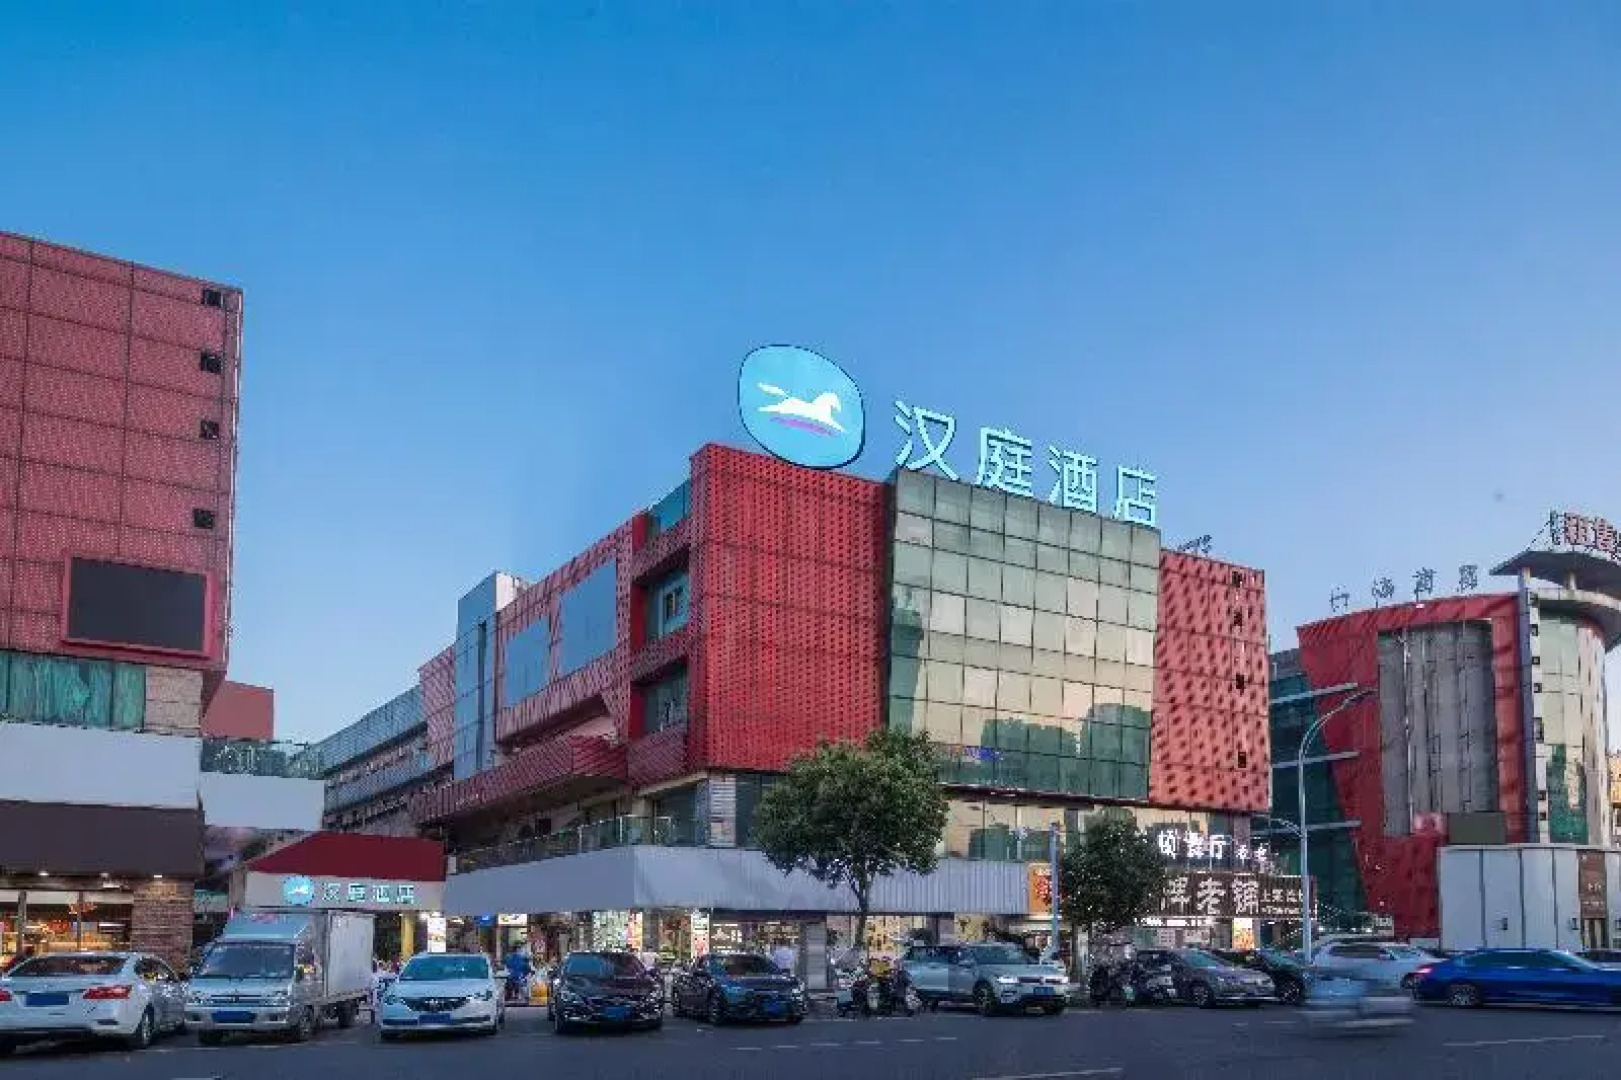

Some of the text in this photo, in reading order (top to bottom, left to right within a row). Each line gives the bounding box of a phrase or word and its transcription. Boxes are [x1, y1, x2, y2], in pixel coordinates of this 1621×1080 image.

[893, 400, 1159, 527] 汉庭酒店
[322, 882, 414, 905] 汉庭酒店
